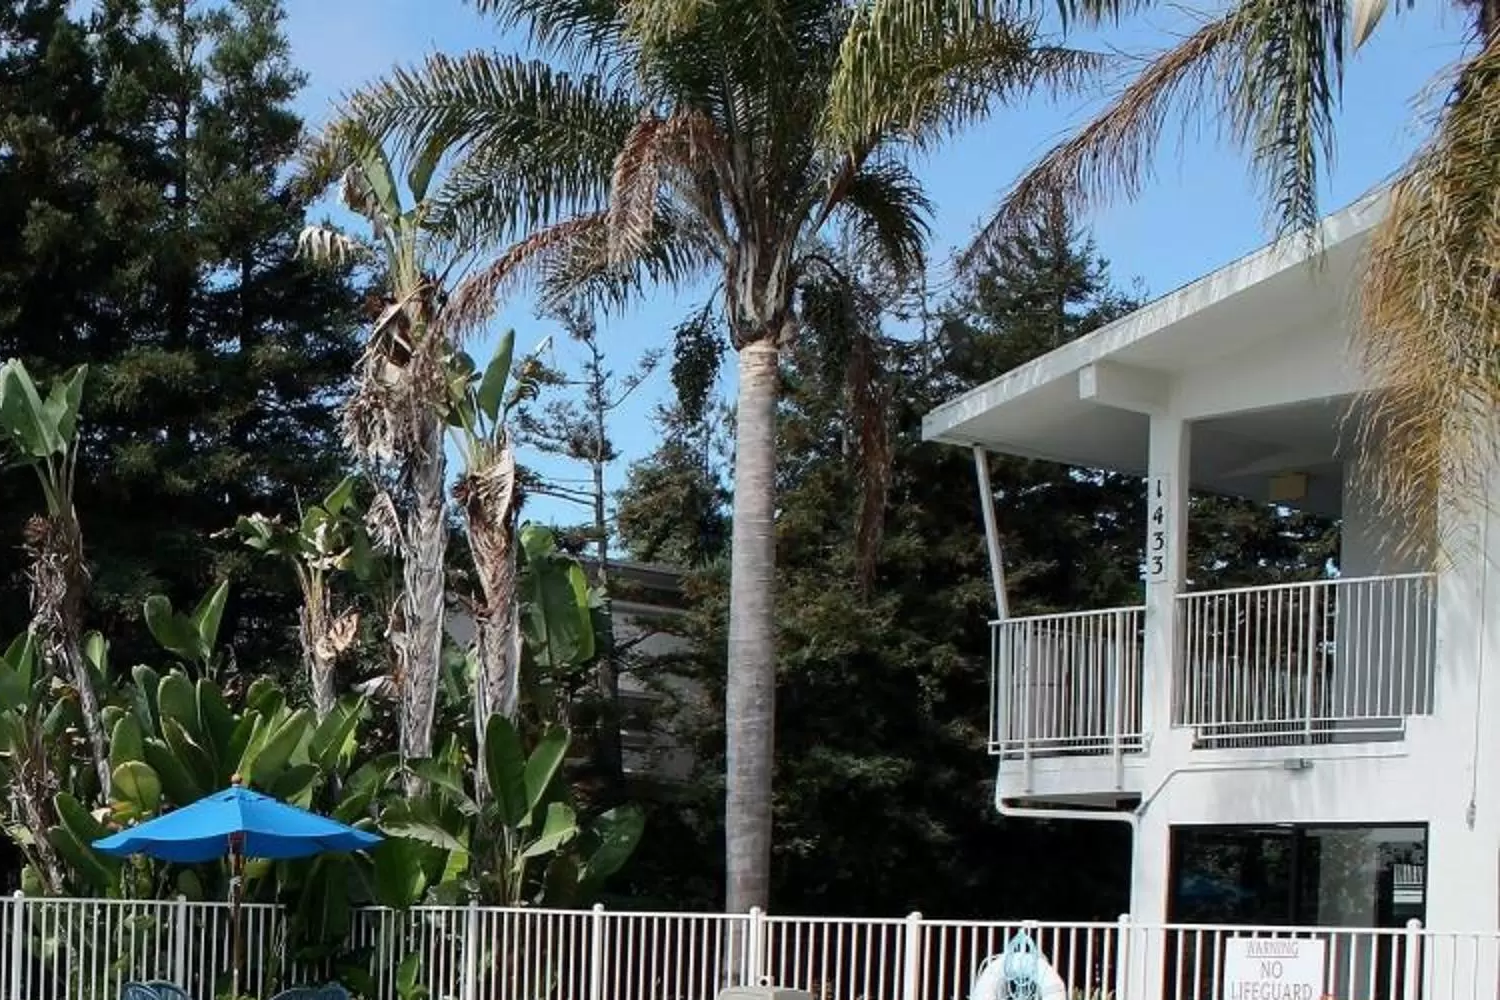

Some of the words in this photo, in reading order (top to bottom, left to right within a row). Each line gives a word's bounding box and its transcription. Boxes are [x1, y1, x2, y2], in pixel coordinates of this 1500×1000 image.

[1151, 479, 1164, 575] 1433
[1247, 941, 1300, 955] WARNING
[1261, 961, 1283, 979] NO
